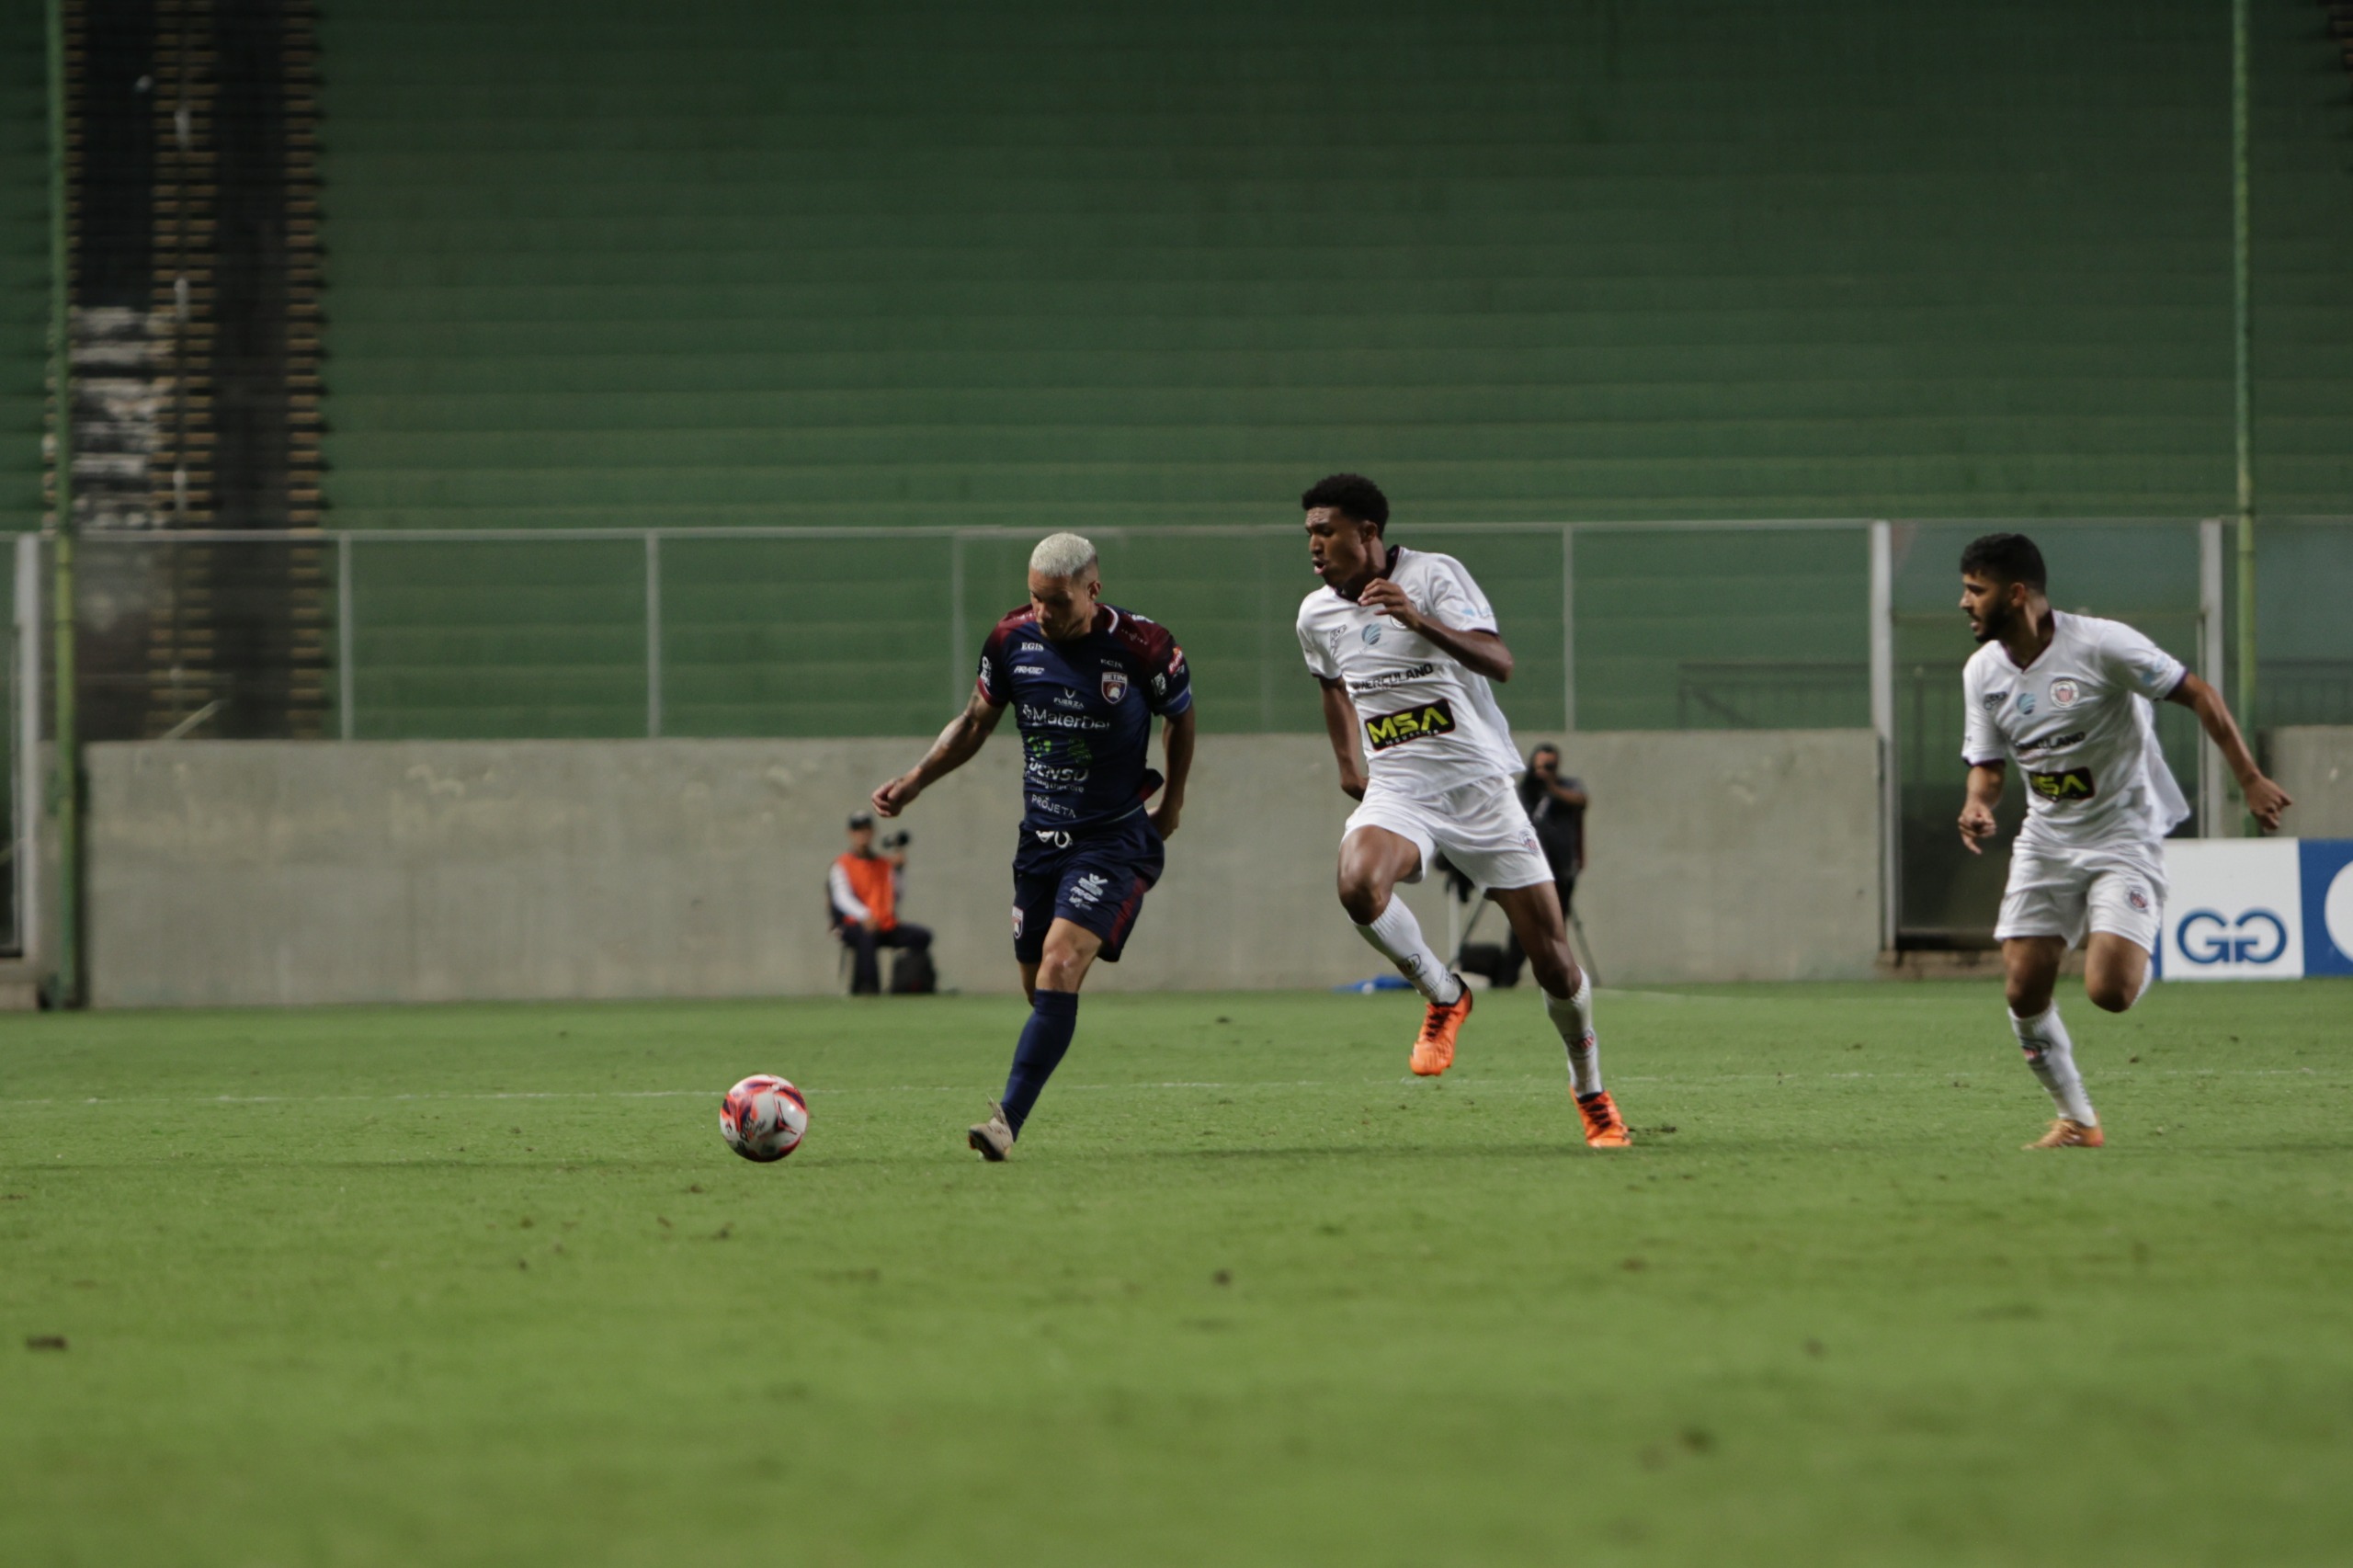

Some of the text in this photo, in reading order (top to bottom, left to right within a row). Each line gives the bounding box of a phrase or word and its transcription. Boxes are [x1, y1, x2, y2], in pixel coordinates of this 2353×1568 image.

[1021, 642, 1044, 652] EGIS
[1104, 673, 1127, 681] BETIM
[1367, 707, 1449, 744] MSA
[1031, 793, 1076, 818] PROJETA
